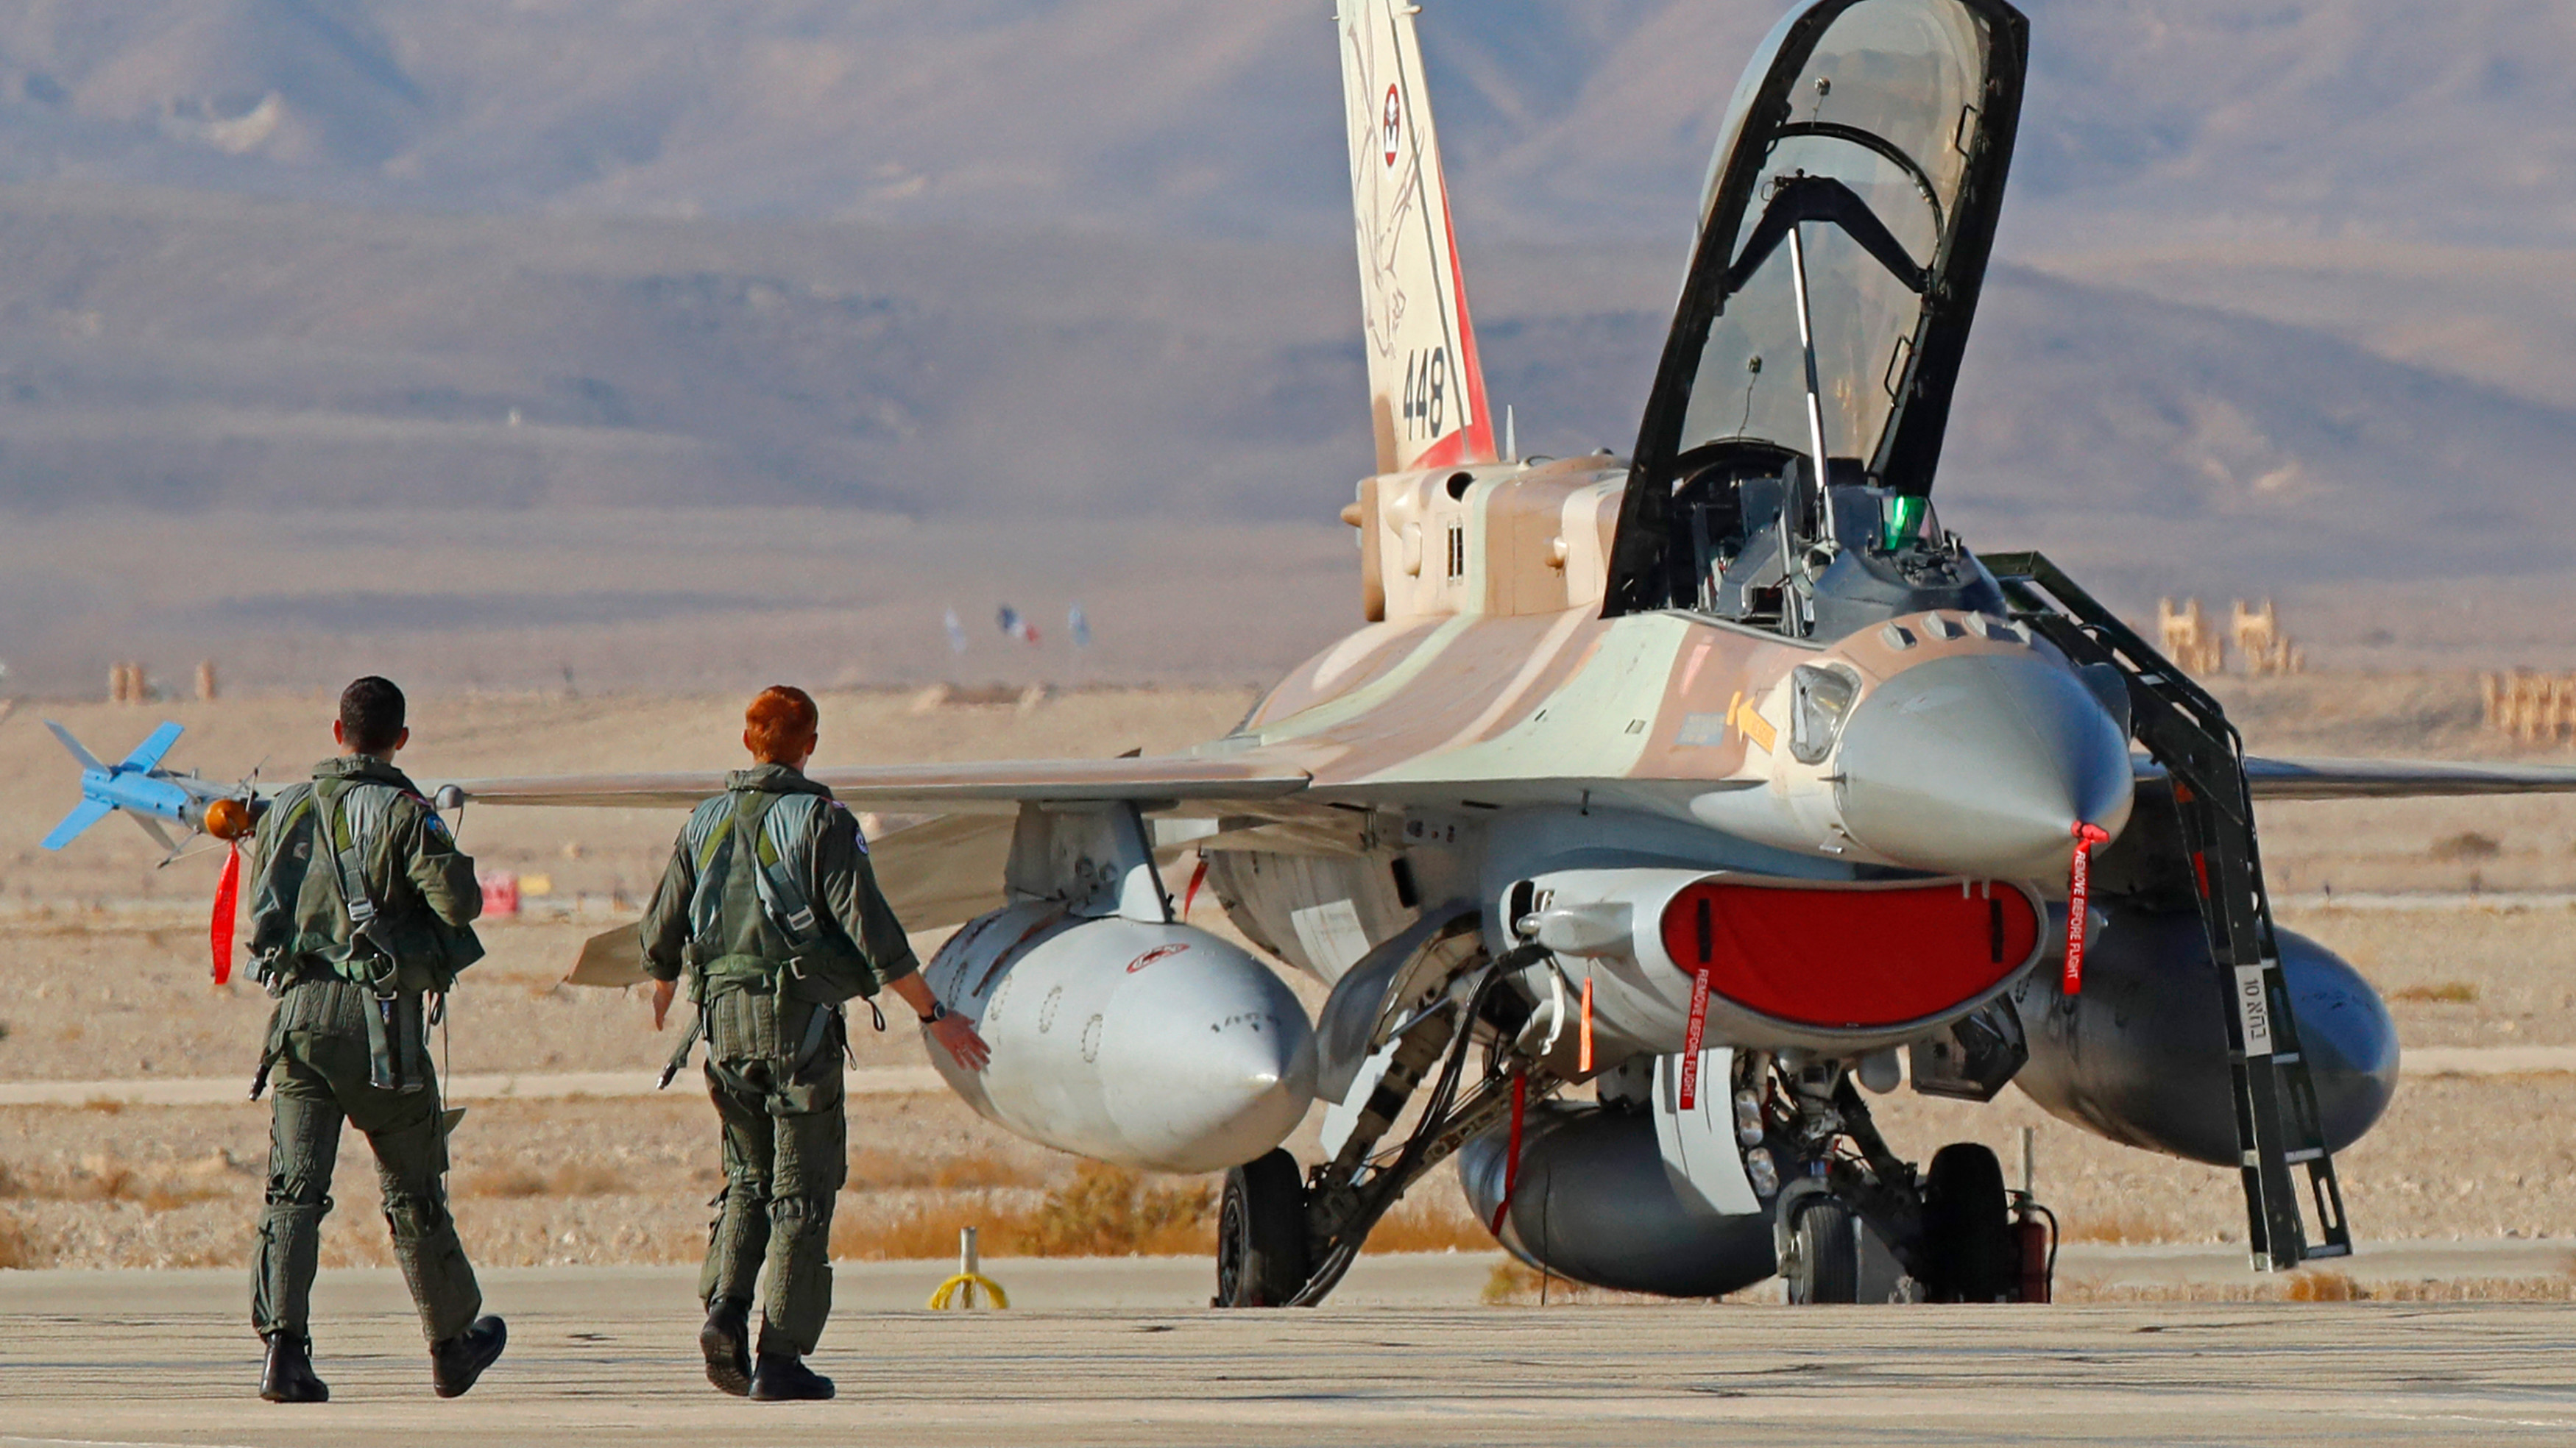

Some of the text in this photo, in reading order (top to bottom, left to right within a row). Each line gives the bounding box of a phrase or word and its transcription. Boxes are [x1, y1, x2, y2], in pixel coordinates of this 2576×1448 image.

[1404, 347, 1444, 441] 448
[2067, 851, 2086, 979] REMOVE BEFORE FLIGHT
[1683, 968, 1708, 1098] REMOVE BEFORE FLIGHT
[2244, 979, 2260, 996] 10
